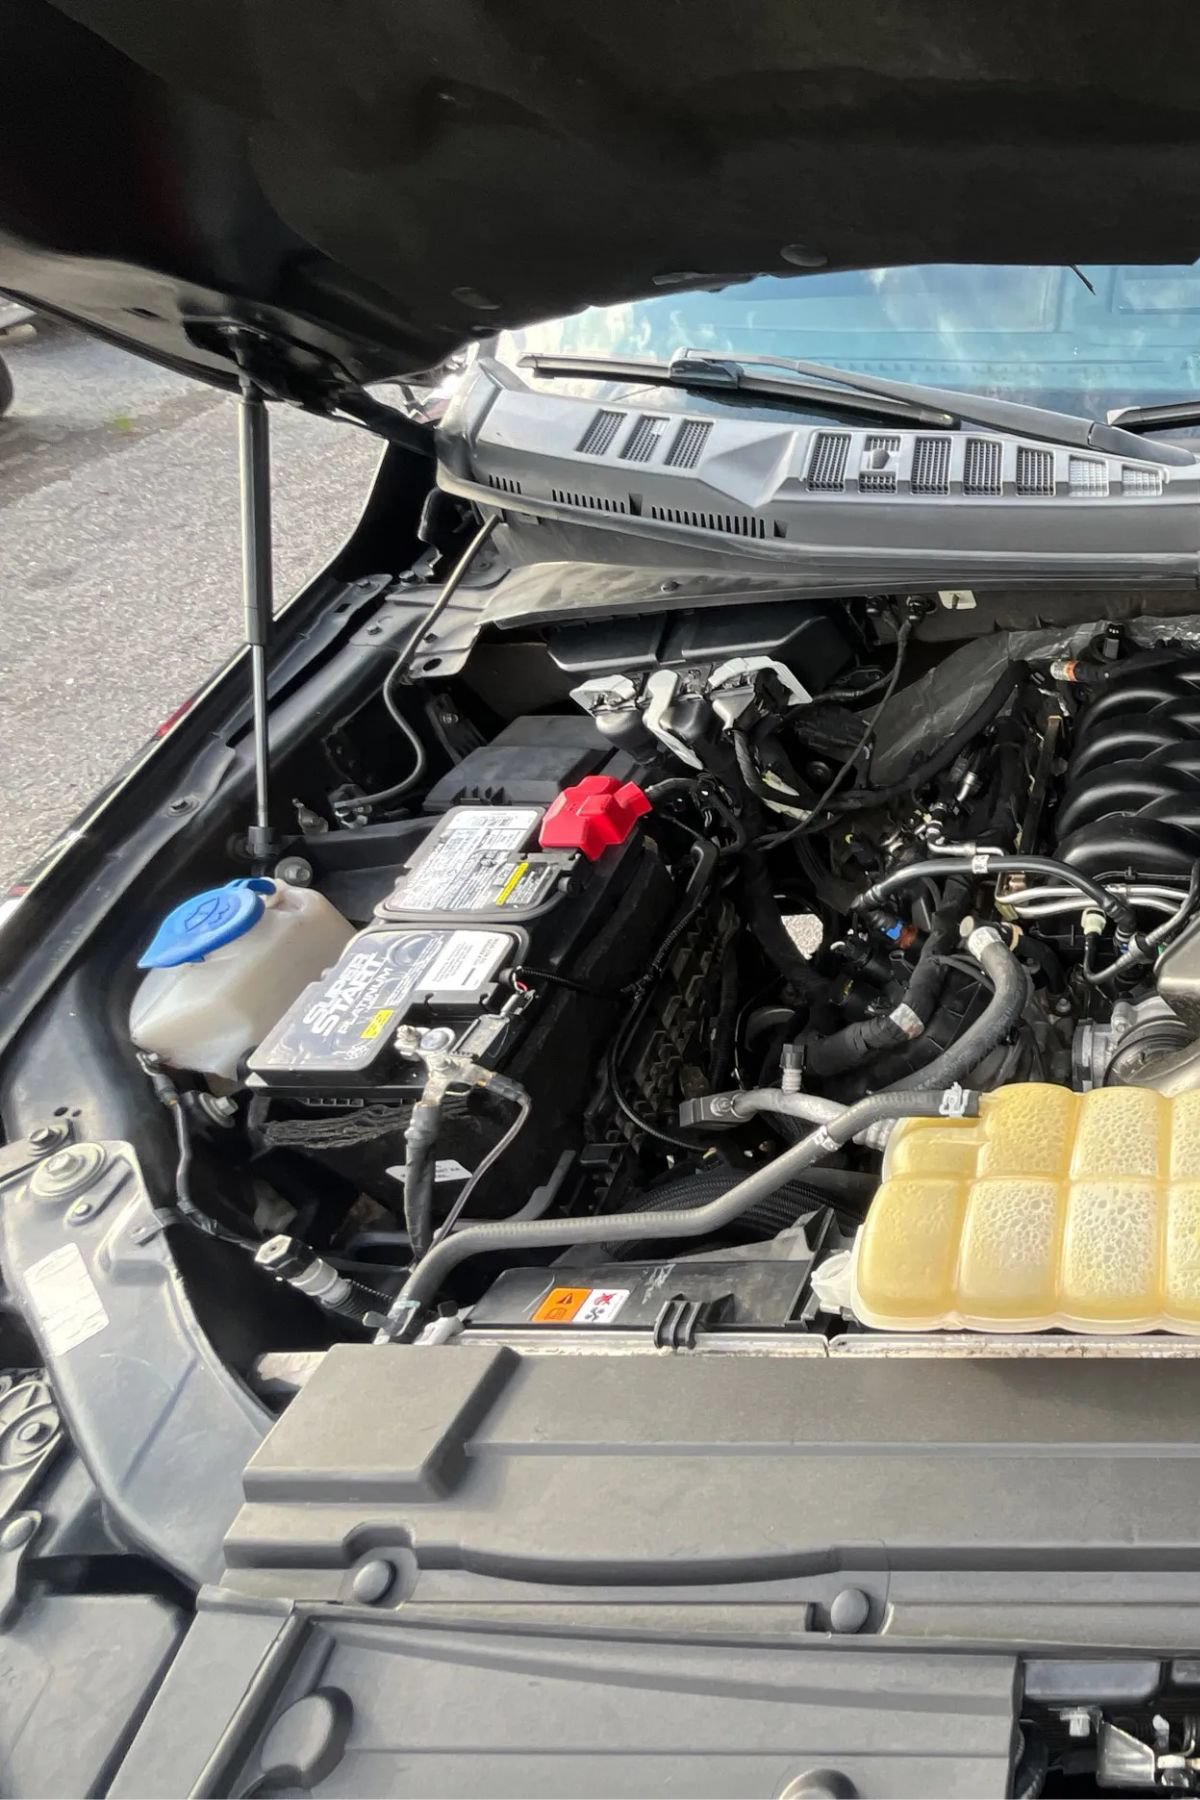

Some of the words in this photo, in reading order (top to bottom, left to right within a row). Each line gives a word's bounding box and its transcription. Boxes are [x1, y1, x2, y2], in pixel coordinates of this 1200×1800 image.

[303, 953, 369, 1024] SUPER
[311, 951, 384, 1036] START
[338, 967, 394, 1034] PLATINUM
